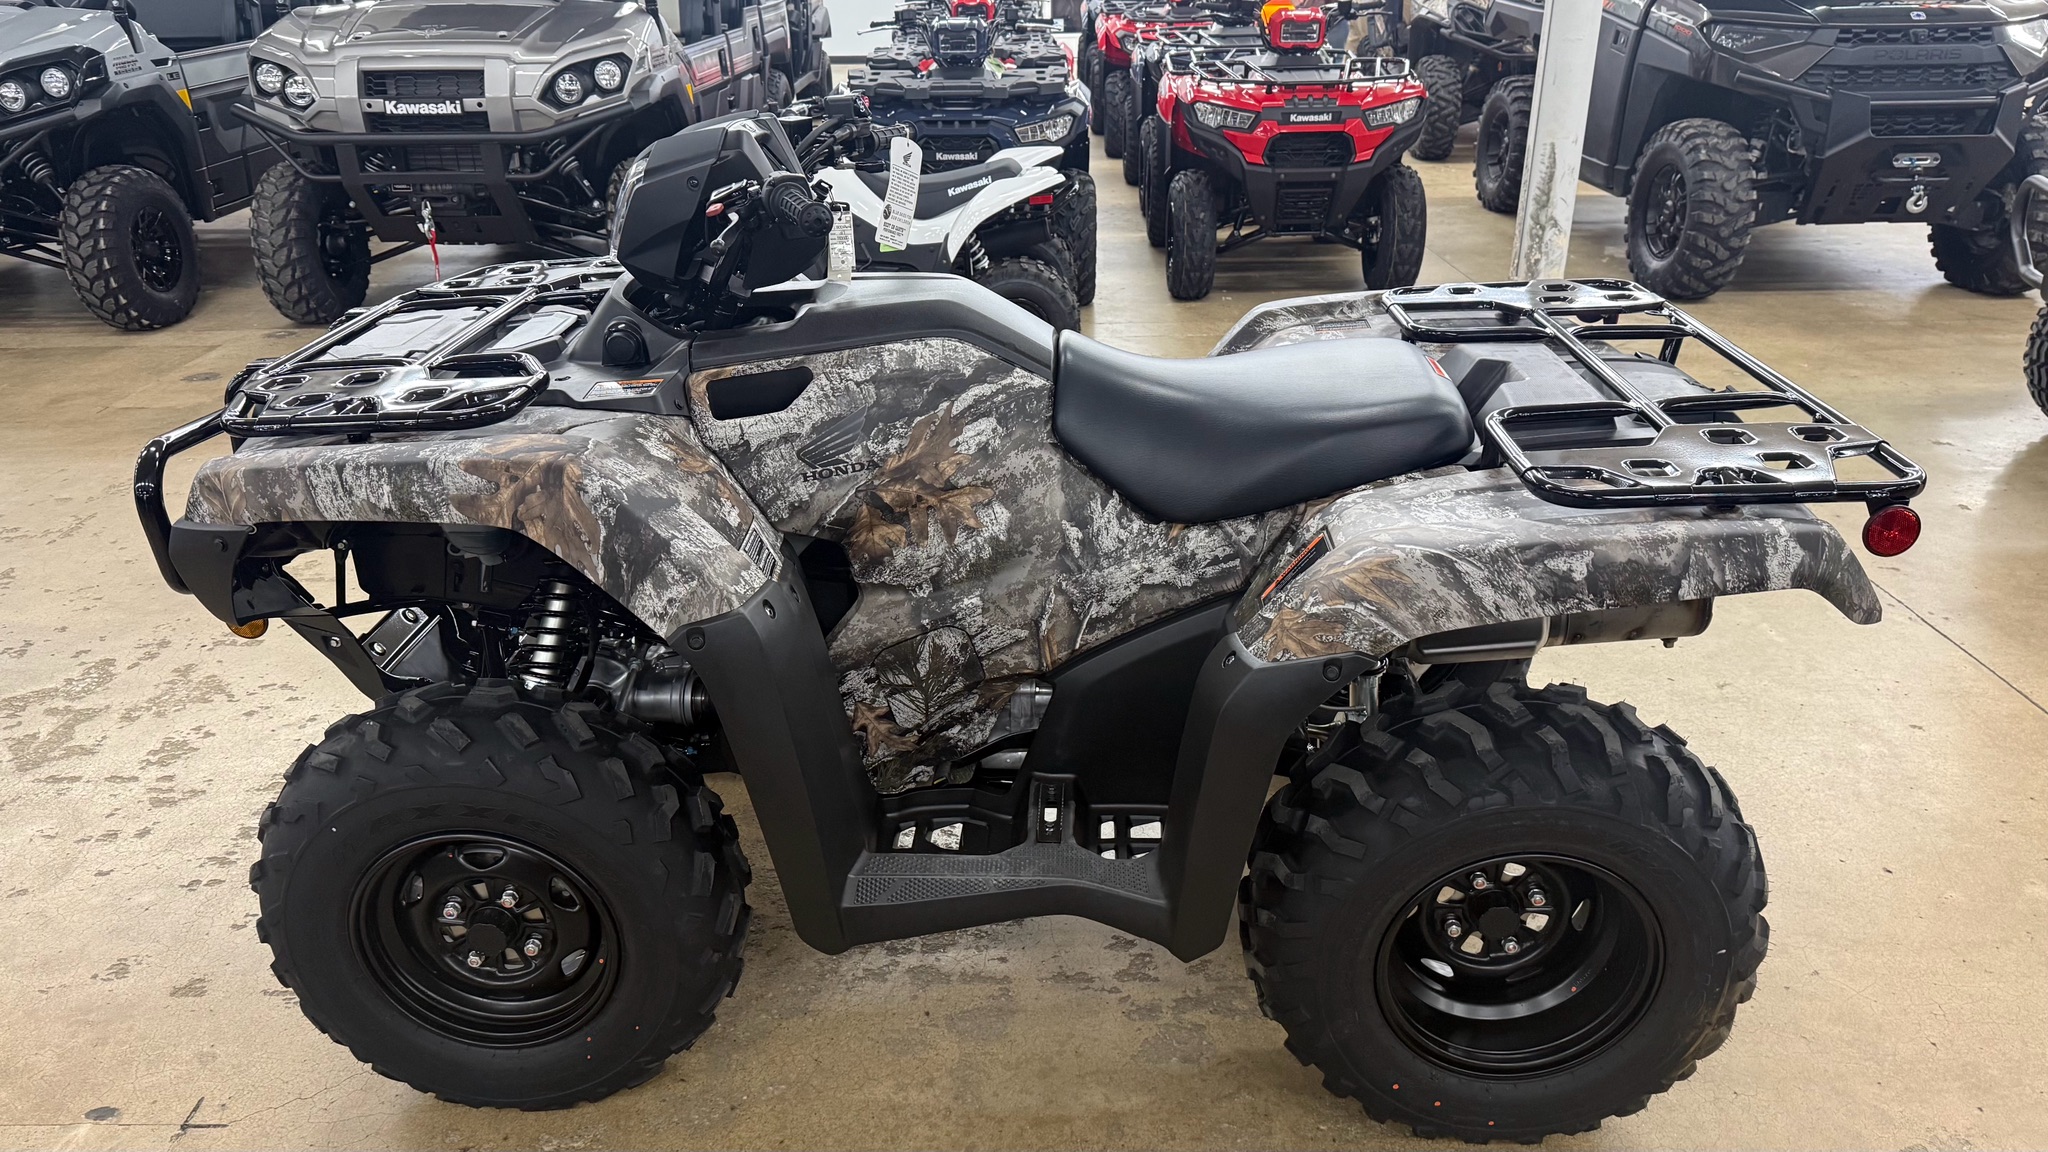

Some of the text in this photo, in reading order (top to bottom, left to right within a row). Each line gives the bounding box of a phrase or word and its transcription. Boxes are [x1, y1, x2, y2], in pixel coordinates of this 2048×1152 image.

[1873, 48, 1962, 60] POLARIS
[385, 100, 462, 114] Kawasaki
[1289, 112, 1332, 122] Kawasaki
[935, 151, 978, 160] Kawasaki
[947, 175, 993, 197] Kawasaki
[800, 461, 883, 482] HONDA
